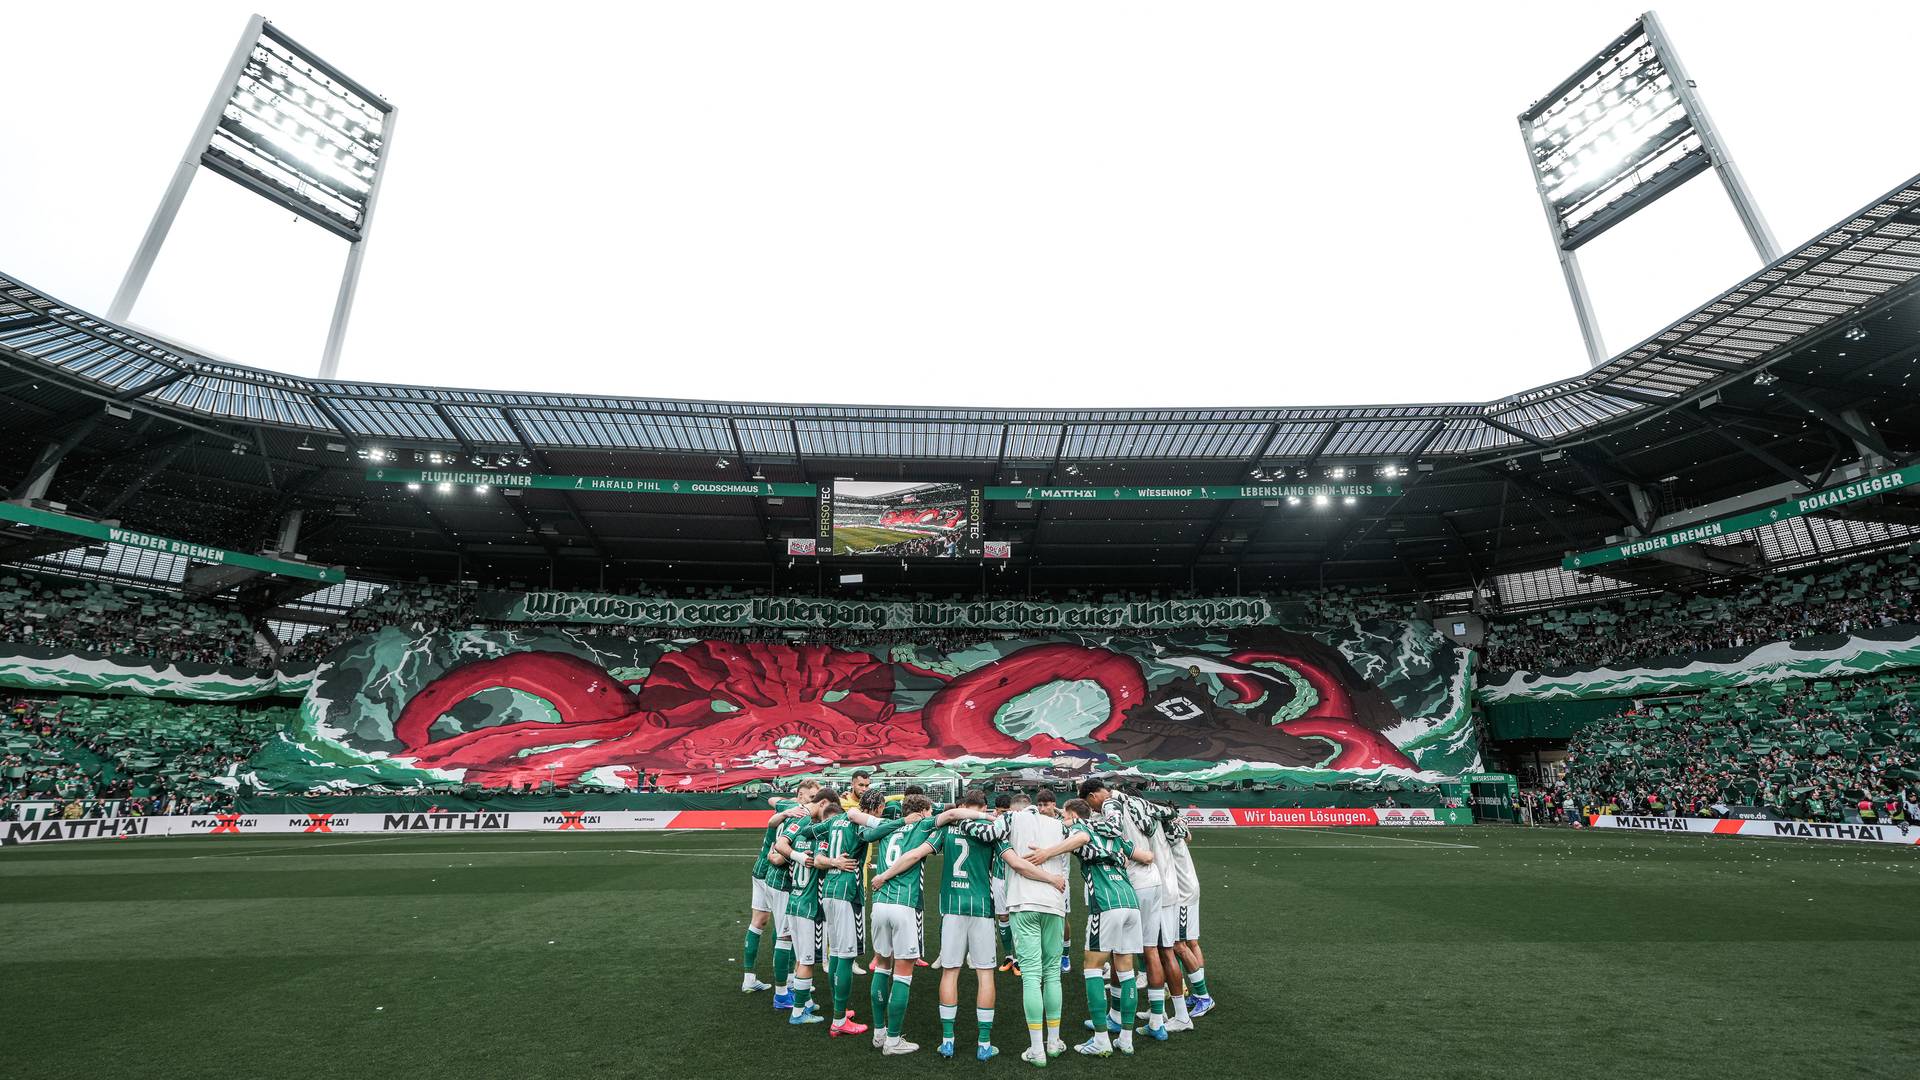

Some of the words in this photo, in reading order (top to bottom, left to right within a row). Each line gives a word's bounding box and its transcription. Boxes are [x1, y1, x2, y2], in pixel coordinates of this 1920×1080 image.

[421, 471, 532, 486] FLUTLICHTPARTNER
[592, 479, 633, 490] HARALD
[637, 481, 660, 491] PIHL
[691, 483, 759, 493] GOLDSCHMAUS
[1041, 489, 1096, 498] MATTHÄI
[1138, 488, 1192, 497] WIESENHOF
[1241, 486, 1304, 497] LEBENSLANG
[1307, 484, 1373, 496] GRÜN-WEISS
[1799, 473, 1903, 512] POKALSIEGER
[820, 487, 831, 538] PERSOTEC
[970, 489, 980, 539] PERSOTEC
[109, 528, 167, 550] WERDER
[171, 541, 224, 561] BREMEN
[1620, 536, 1668, 557] WERDER
[1671, 523, 1722, 545] BREMEN
[524, 592, 581, 615] Wir
[583, 597, 679, 622] waren
[682, 602, 746, 624] euer
[750, 597, 887, 629] Untergang
[912, 601, 962, 626] Wir
[965, 600, 1060, 626] bleiben
[1063, 606, 1125, 627] euer
[1127, 598, 1270, 627] Untergang
[191, 818, 258, 828] MATTHÄI
[289, 818, 349, 827] MATTHÄI
[383, 813, 510, 830] MATTHÄI
[543, 815, 601, 825] MATTHÄI
[1244, 810, 1266, 822] Wir
[1269, 810, 1306, 822] bauen
[1310, 809, 1371, 824] Lösungen.
[1739, 811, 1767, 820] ewe.de
[7, 818, 148, 841] MATTHÄI
[1616, 816, 1689, 831] MATTHÄI
[1774, 822, 1884, 841] MATTHÄI
[829, 829, 843, 858] 11
[885, 832, 904, 868] 6
[953, 838, 970, 878] 2
[951, 880, 970, 889] DEMAN
